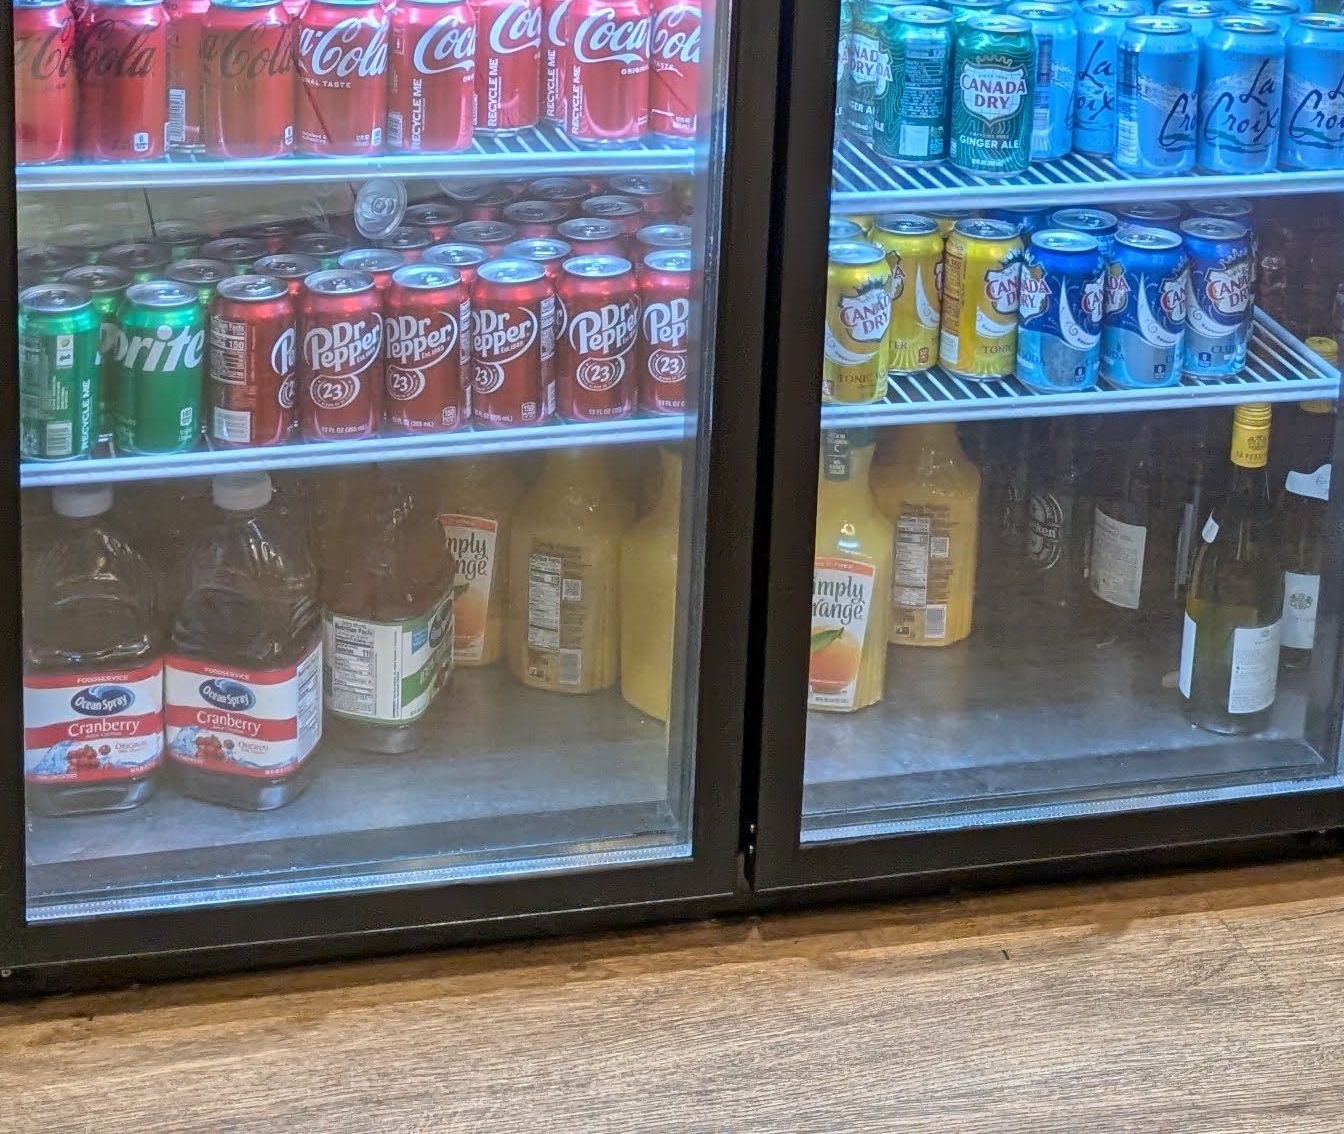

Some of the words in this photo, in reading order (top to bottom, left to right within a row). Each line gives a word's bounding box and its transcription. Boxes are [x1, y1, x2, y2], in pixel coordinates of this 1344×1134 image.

[489, 58, 499, 75] ME
[573, 65, 582, 83] ME
[413, 78, 423, 97] ME
[547, 68, 557, 117] RECYCLE
[960, 72, 1027, 95] CANADA
[1239, 57, 1276, 108] La
[487, 76, 498, 127] RECYCLE
[571, 85, 581, 134] RECYCLE
[975, 95, 1011, 111] DRY
[411, 97, 422, 150] RECYCLE
[959, 135, 998, 148] GINGER
[1000, 139, 1019, 150] ALE
[480, 309, 511, 334] Dr
[601, 302, 632, 328] Dr
[333, 320, 366, 349] Dr
[385, 317, 452, 365] Pepper
[399, 315, 432, 344] Dr
[311, 324, 381, 373] Pepper
[474, 366, 488, 386] 23
[591, 365, 610, 383] 23
[661, 356, 680, 375] 23
[322, 382, 343, 401] 23
[392, 373, 409, 392] 23
[81, 398, 90, 450] RECYCLE
[75, 696, 102, 711] Ocean
[102, 694, 128, 712] Spray
[202, 686, 227, 703] Ocean
[226, 693, 250, 708] Spray
[68, 718, 141, 737] Cranberry
[196, 710, 262, 737] Cranberry
